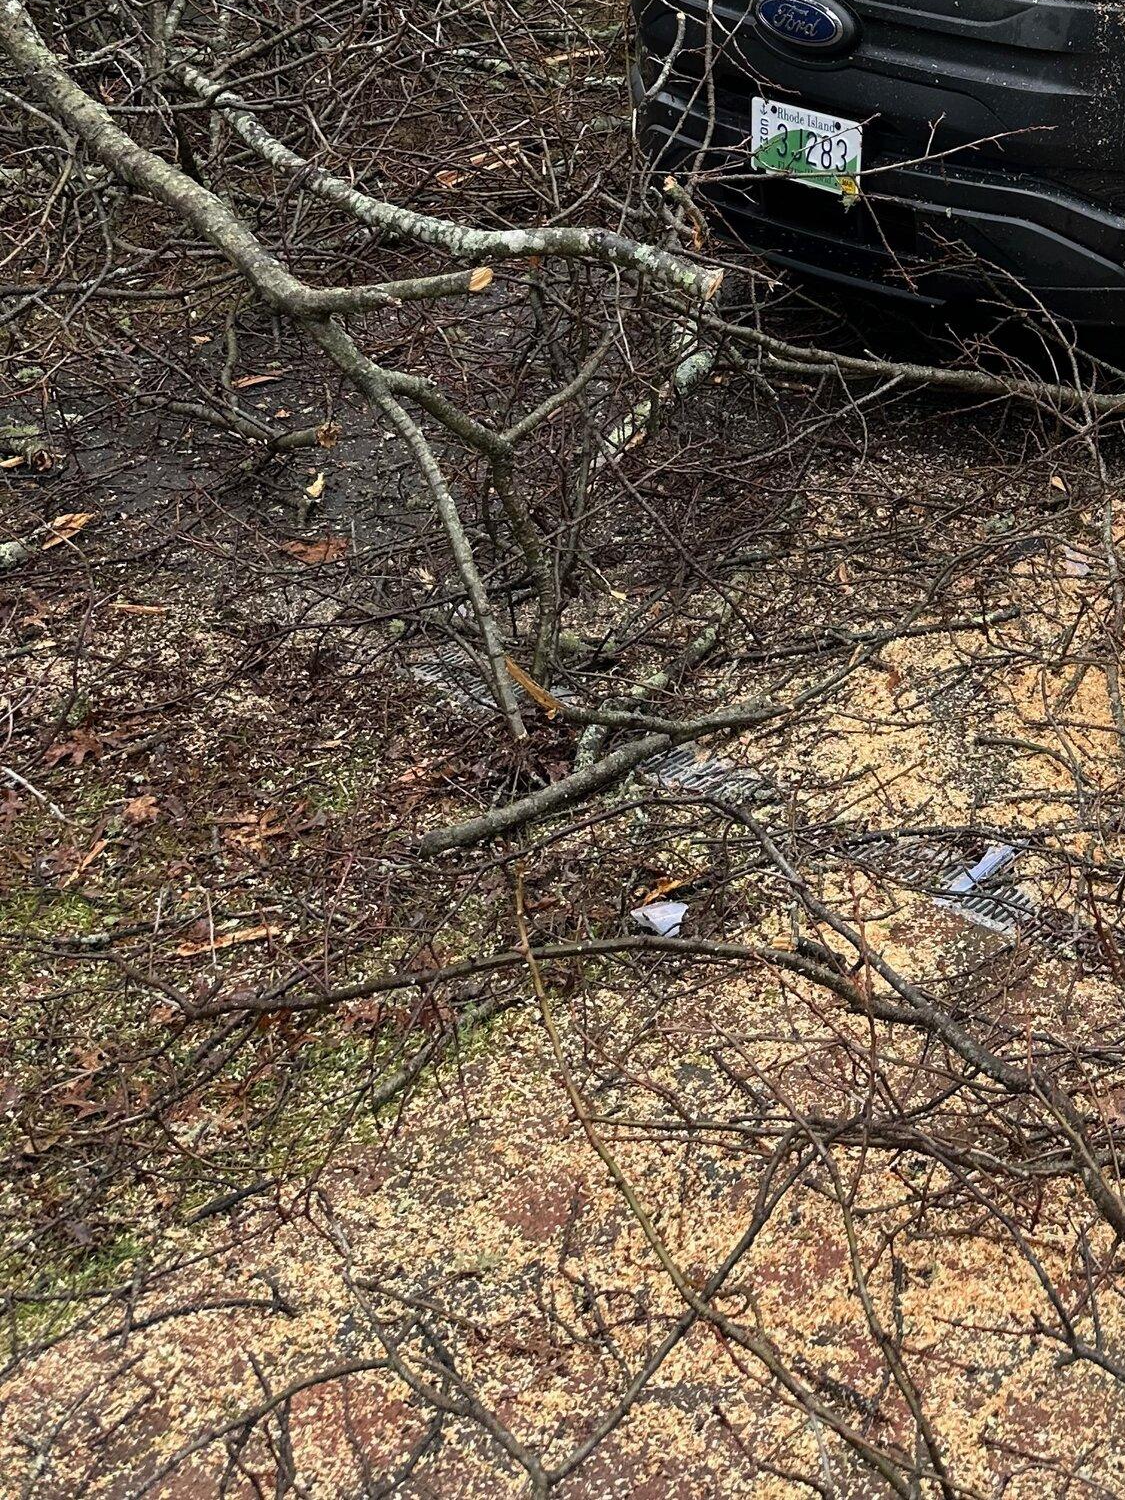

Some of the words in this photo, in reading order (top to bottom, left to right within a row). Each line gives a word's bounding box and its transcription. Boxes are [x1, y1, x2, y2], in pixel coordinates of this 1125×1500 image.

[773, 3, 821, 37] Ford
[777, 106, 805, 126] Rhode
[807, 114, 835, 133] Island
